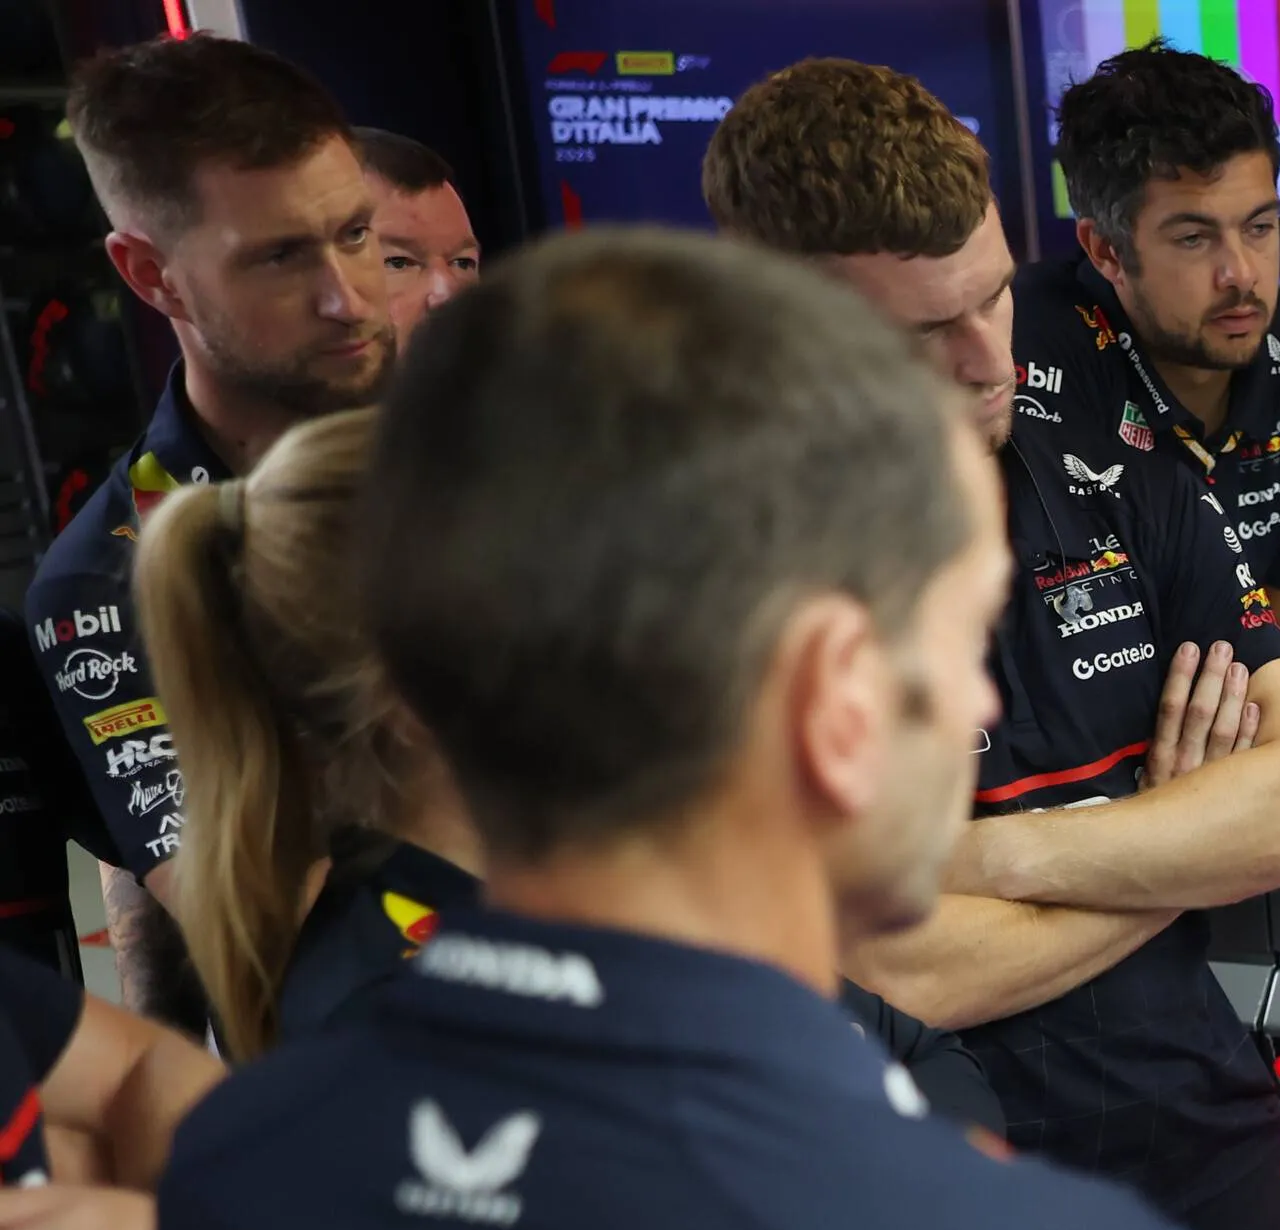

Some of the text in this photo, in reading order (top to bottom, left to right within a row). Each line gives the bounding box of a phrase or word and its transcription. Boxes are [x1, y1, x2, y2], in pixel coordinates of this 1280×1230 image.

[549, 96, 626, 119] GRAN
[1015, 361, 1063, 394] obil
[1128, 348, 1169, 415] 1Password
[1122, 423, 1154, 450] HEUE
[35, 605, 122, 652] Mobil
[1057, 601, 1144, 638] HONDA
[88, 651, 138, 680] Rock
